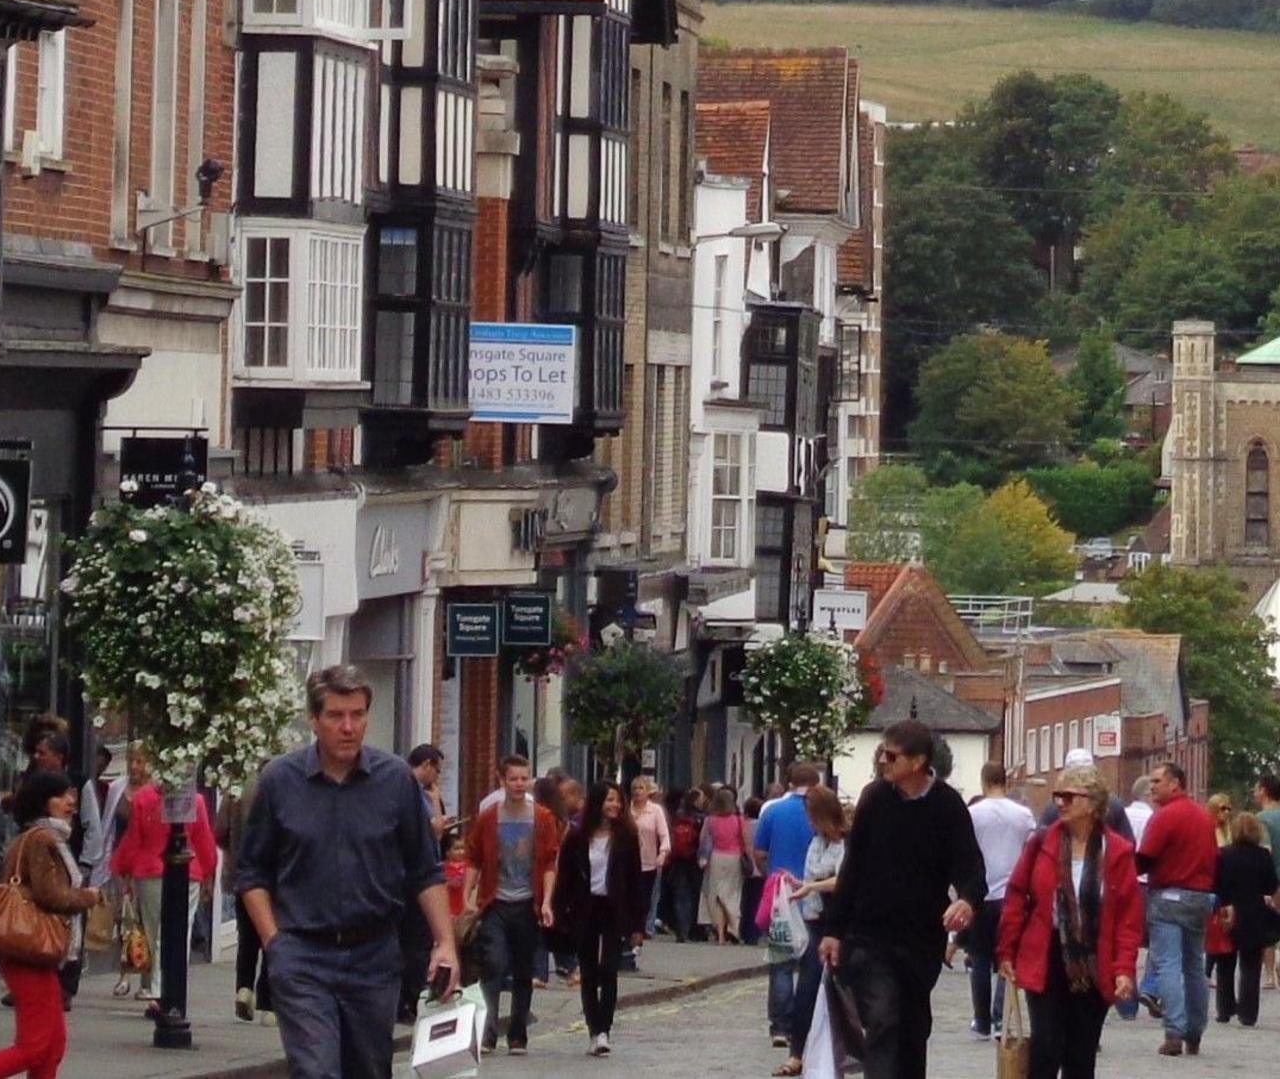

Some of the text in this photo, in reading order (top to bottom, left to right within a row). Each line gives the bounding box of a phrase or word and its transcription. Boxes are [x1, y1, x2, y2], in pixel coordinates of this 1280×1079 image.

[518, 348, 566, 364] Square
[512, 365, 533, 383] To
[538, 366, 567, 383] Let
